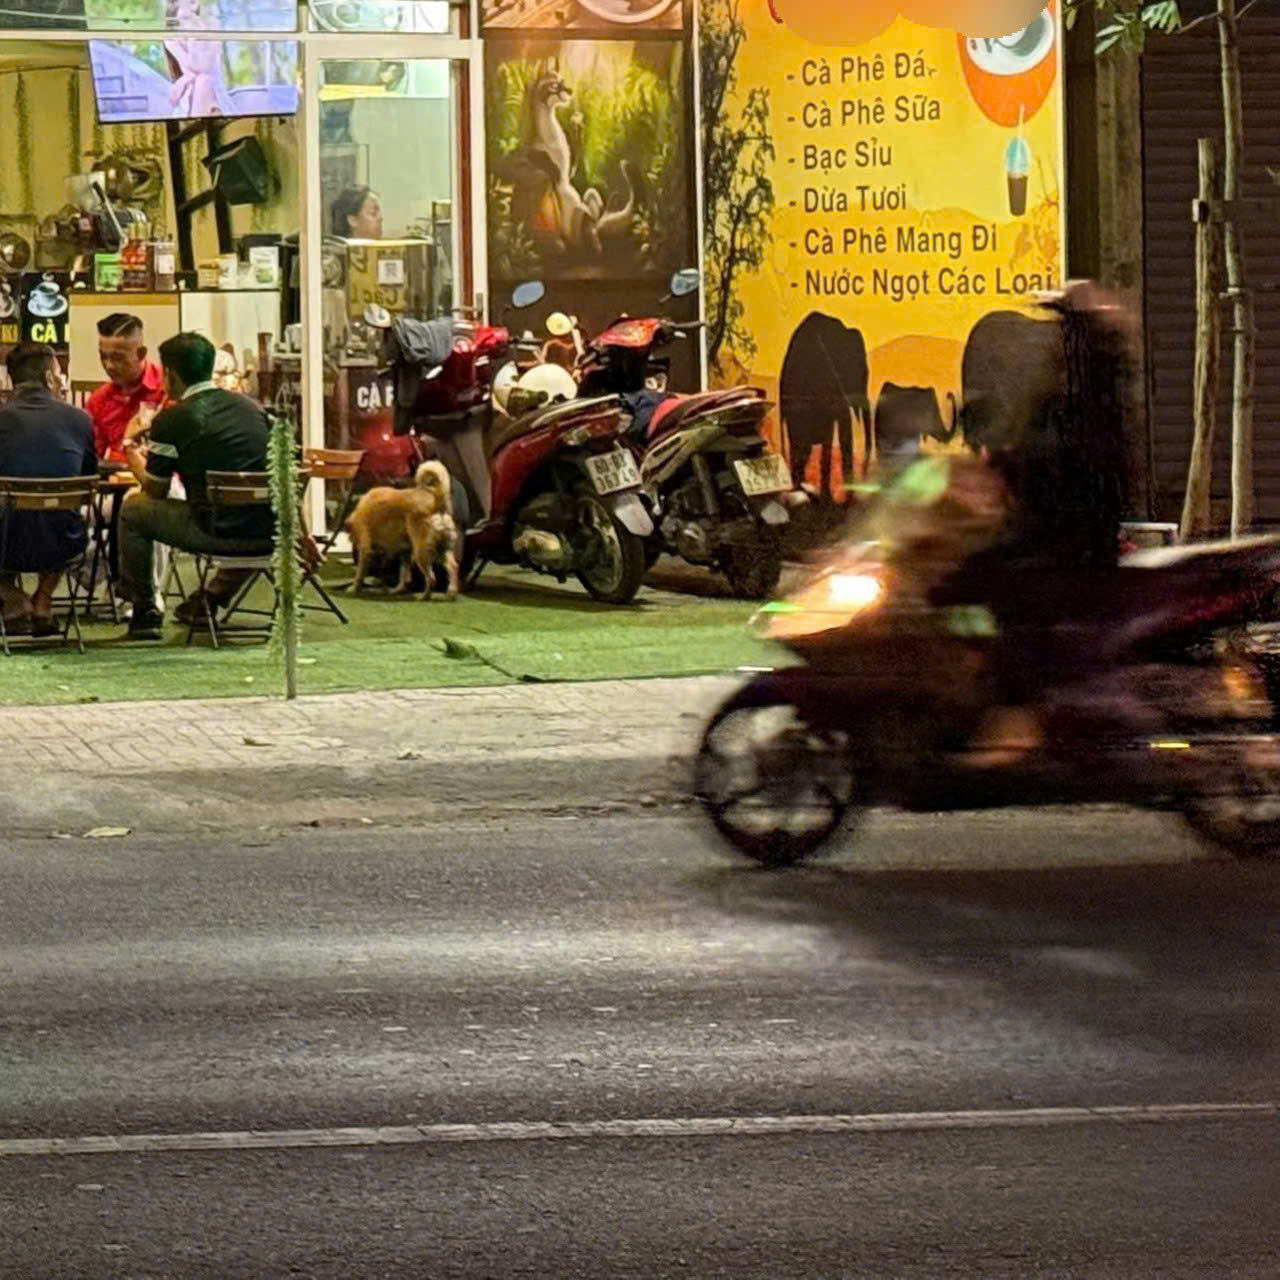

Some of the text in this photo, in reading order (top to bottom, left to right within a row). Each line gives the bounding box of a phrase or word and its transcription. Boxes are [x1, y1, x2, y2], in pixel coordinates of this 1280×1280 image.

[801, 49, 925, 86] Cà Phê Đá
[802, 95, 941, 128] Cà Phê Sữa
[804, 138, 892, 176] Bạc Sỉu
[804, 184, 907, 213] Dừa Tươi
[805, 224, 997, 260] Cà Phê Mang Đi
[805, 269, 864, 296] Nước
[873, 269, 929, 302] Ngọt
[938, 266, 985, 295] Các
[31, 319, 58, 343] CÀ
